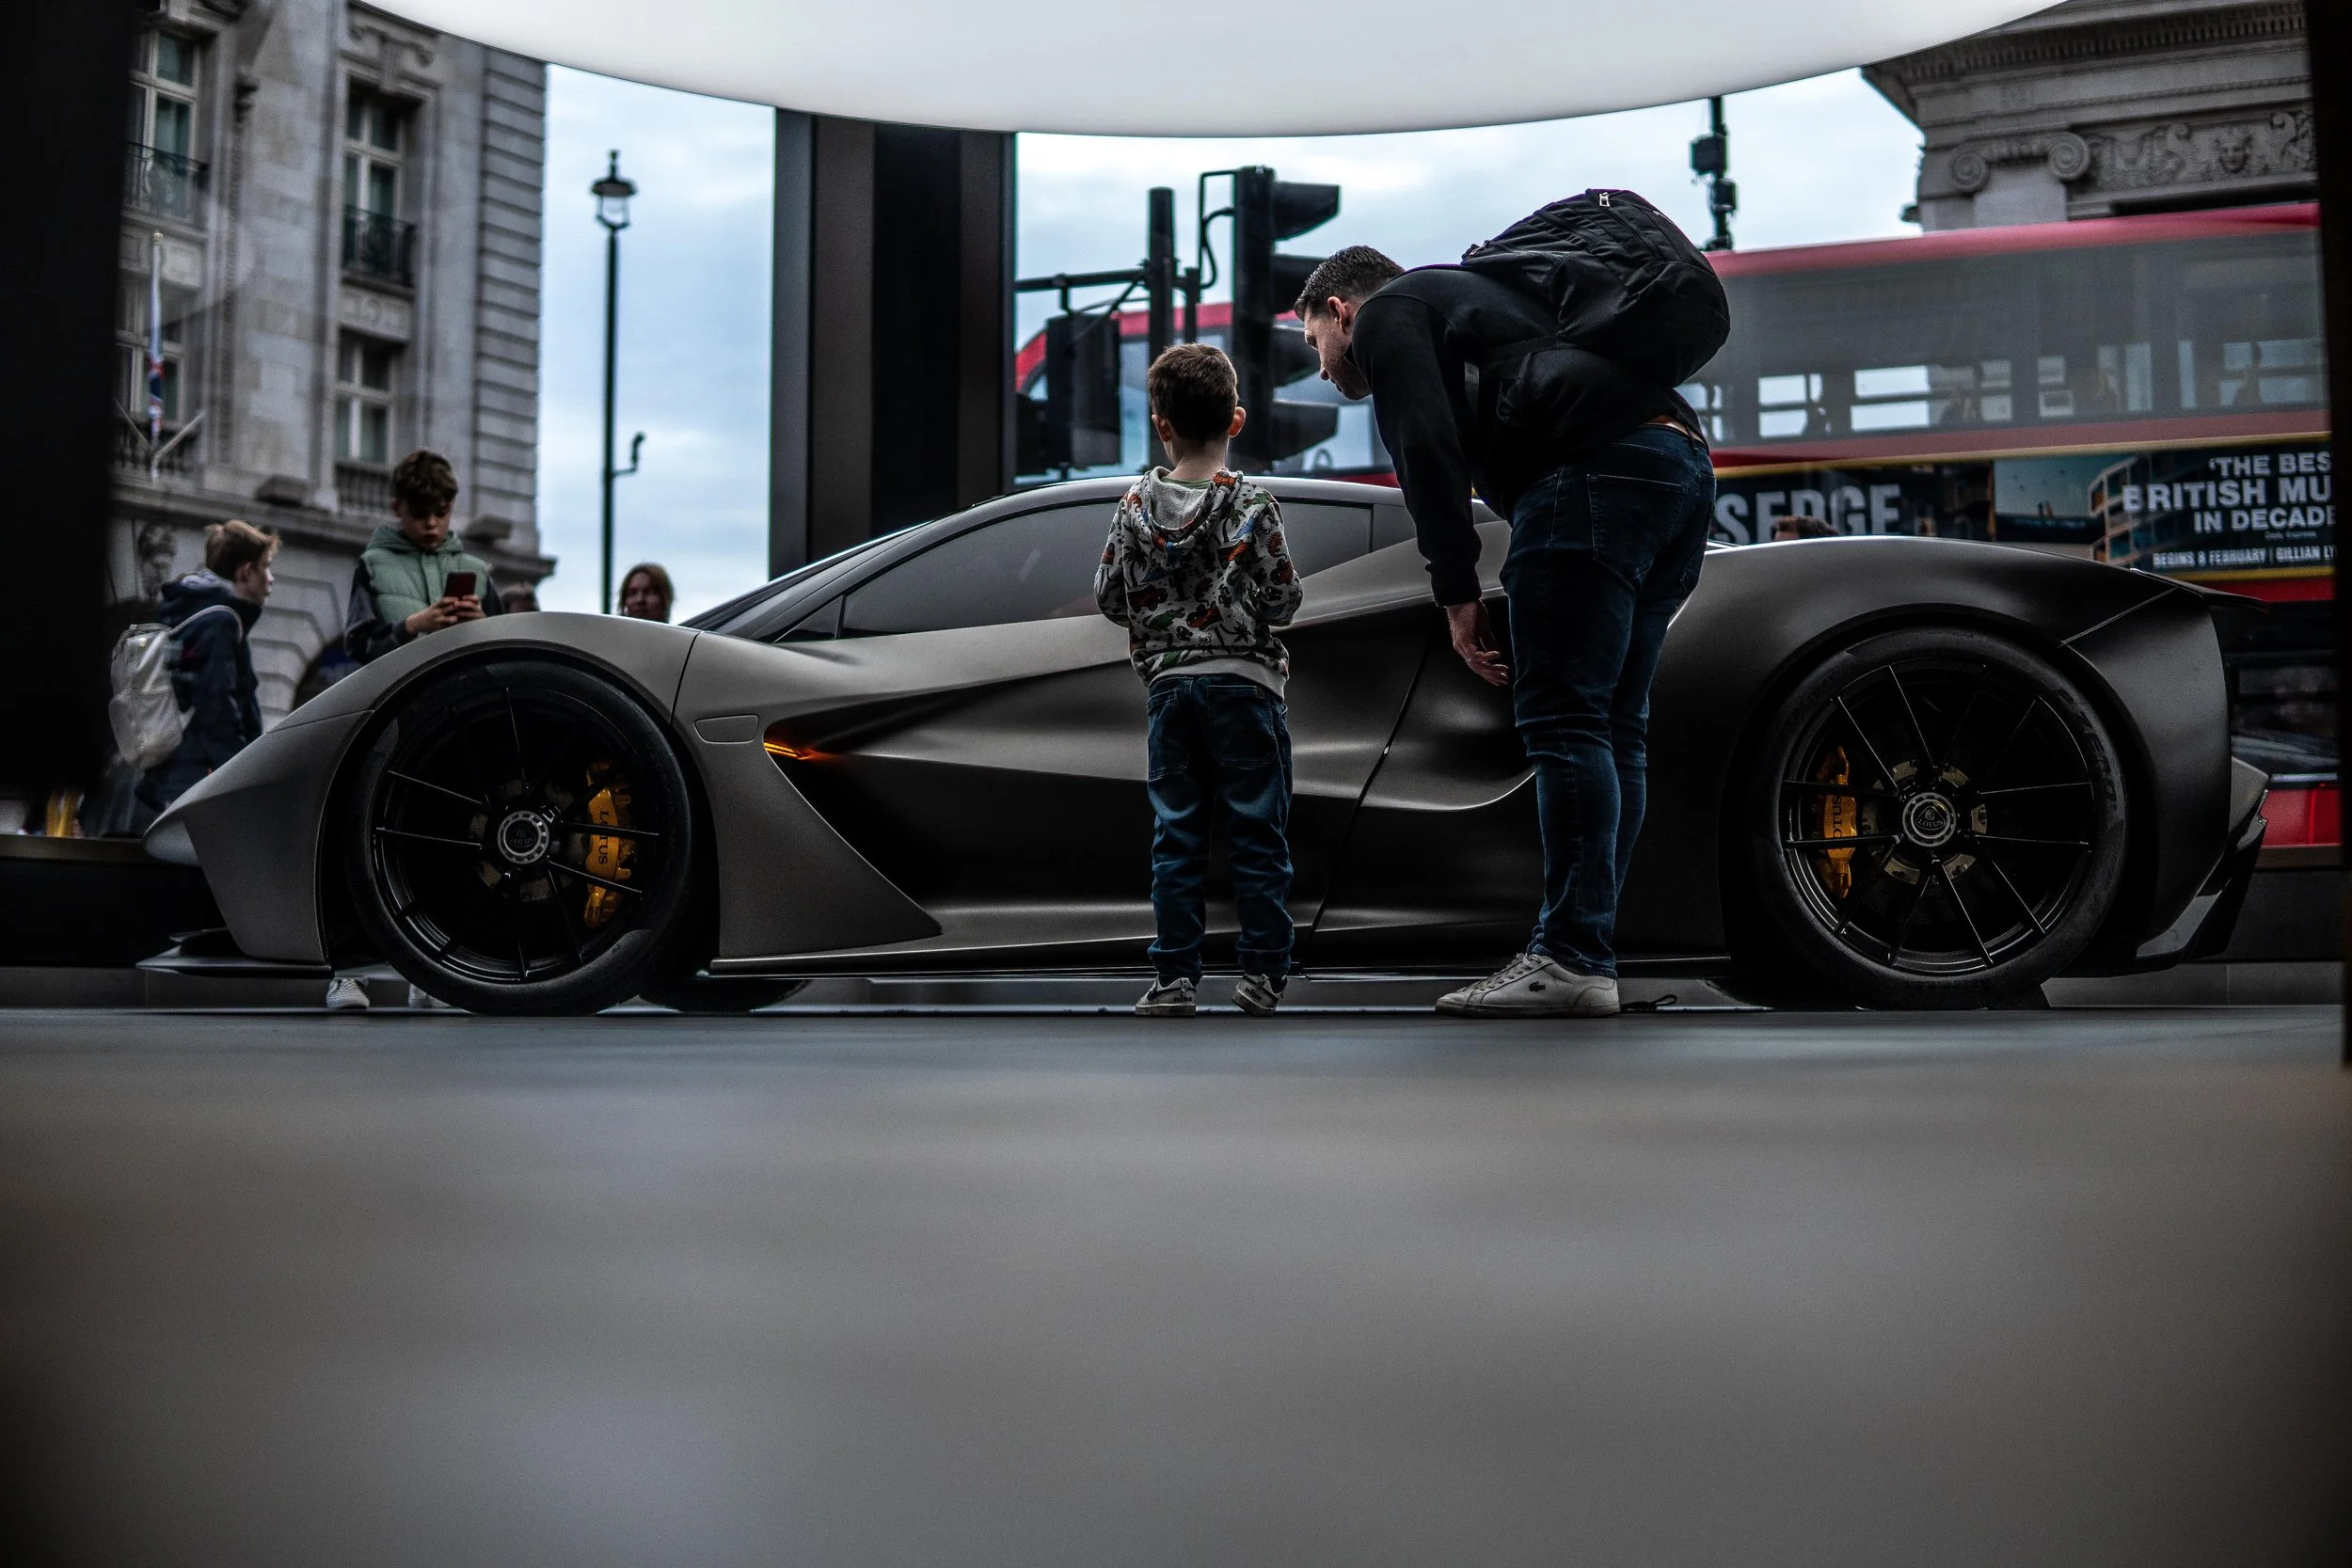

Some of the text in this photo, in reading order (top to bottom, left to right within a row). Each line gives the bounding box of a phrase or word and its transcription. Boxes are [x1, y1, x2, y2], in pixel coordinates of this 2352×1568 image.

[2122, 474, 2331, 513] BRITISH MU
[2193, 511, 2222, 533] IN
[2153, 552, 2196, 570] BEGINS
[2209, 547, 2266, 566] FEBRUARY
[2276, 546, 2321, 563] GILLIAN
[1917, 819, 1944, 828] LOTUS
[1173, 994, 1192, 1003] nike
[1243, 987, 1262, 1002] nike
